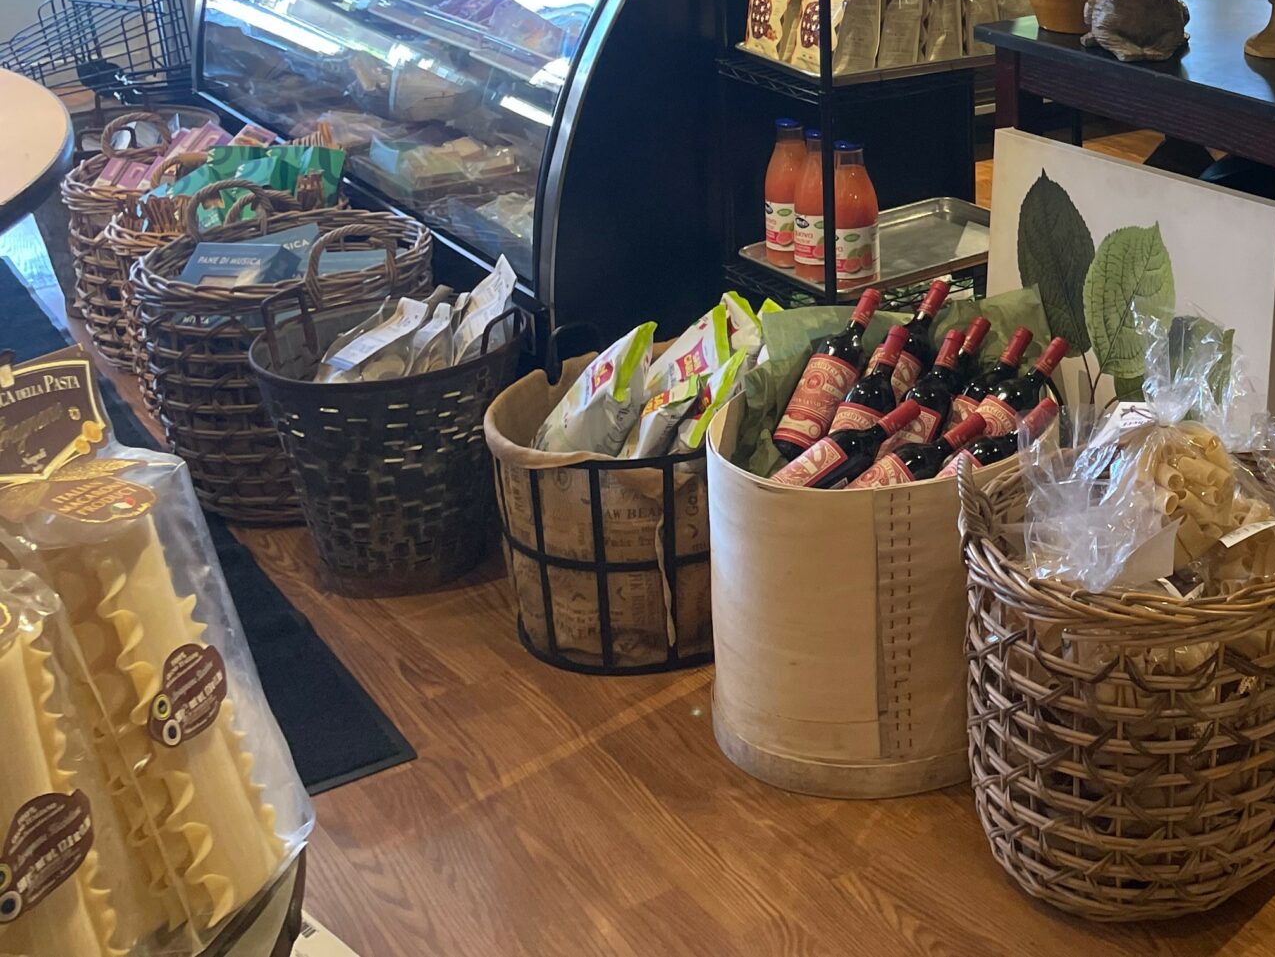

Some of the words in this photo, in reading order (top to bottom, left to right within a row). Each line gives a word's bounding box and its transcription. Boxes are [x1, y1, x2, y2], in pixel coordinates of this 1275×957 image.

[282, 238, 311, 251] SICA
[197, 256, 220, 265] PANE
[219, 256, 229, 265] DI
[228, 257, 262, 266] MUSICA
[75, 486, 138, 516] PRODUCT
[605, 508, 621, 521] AW
